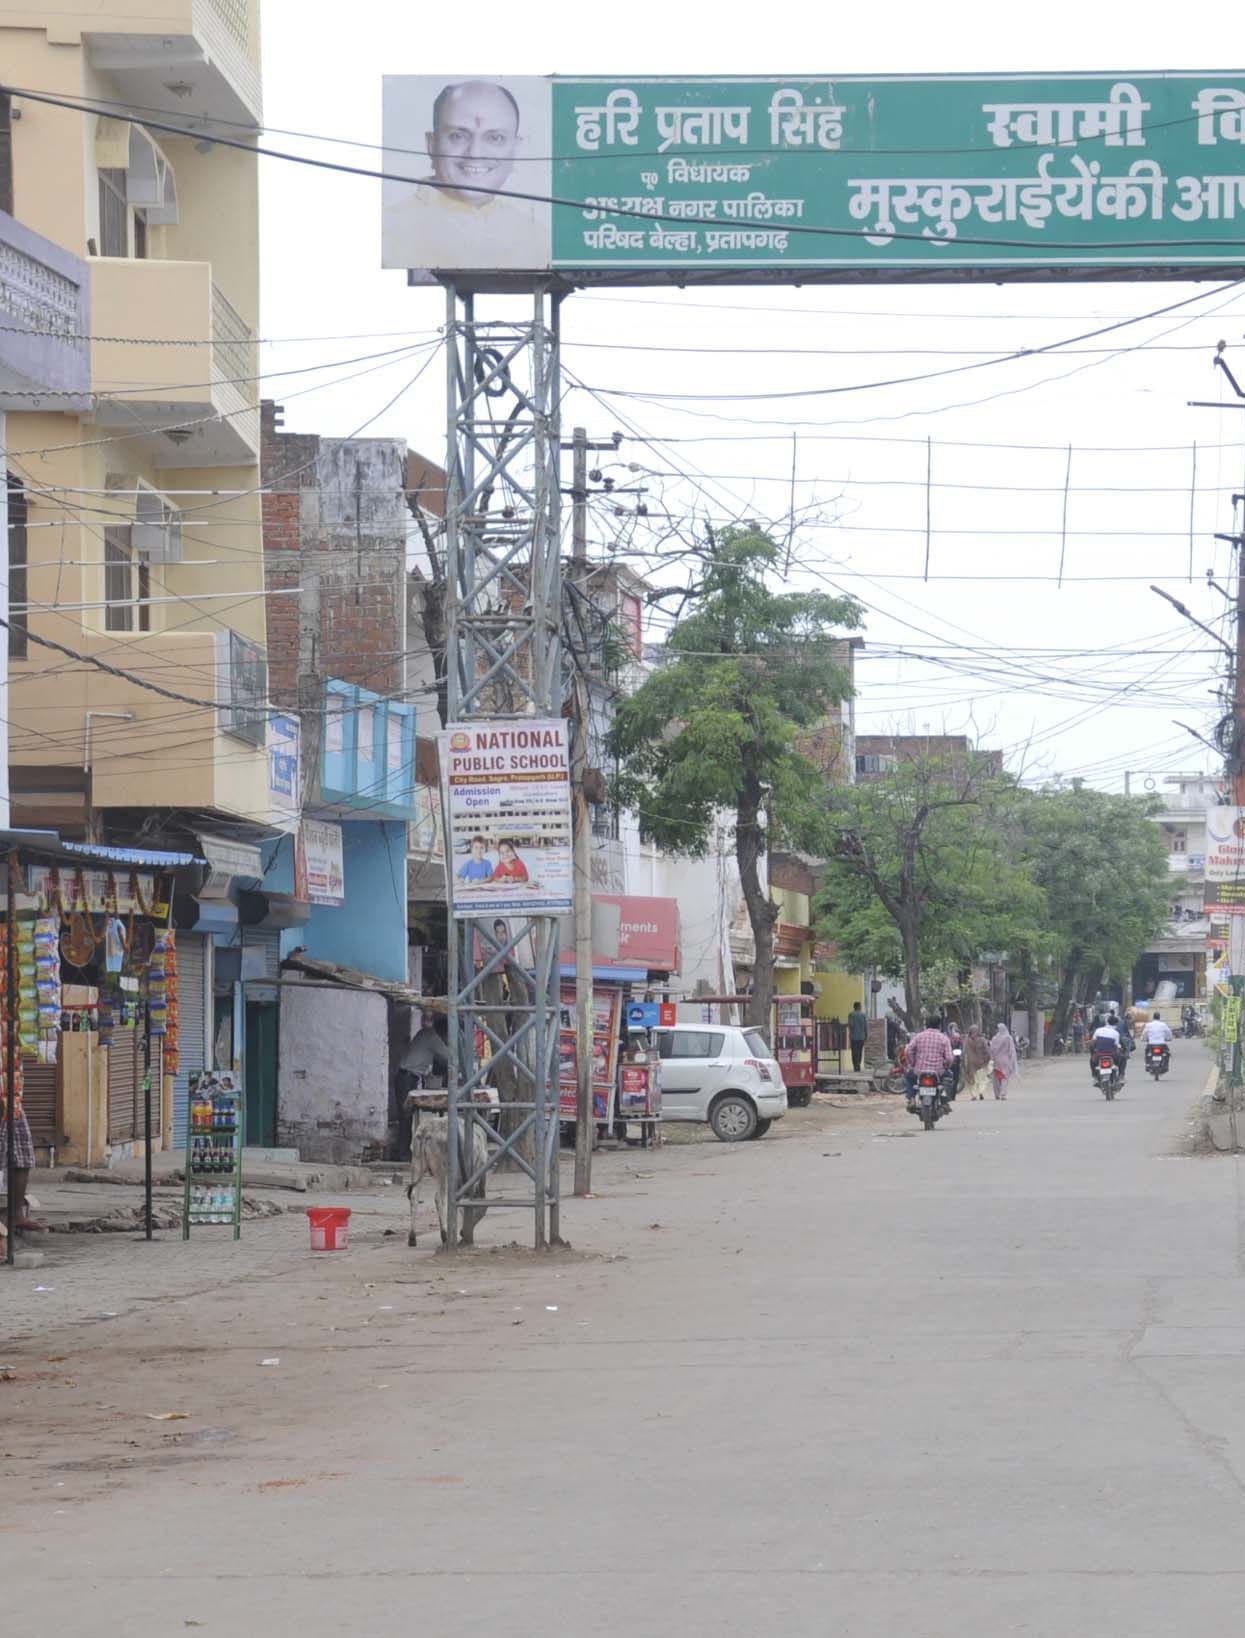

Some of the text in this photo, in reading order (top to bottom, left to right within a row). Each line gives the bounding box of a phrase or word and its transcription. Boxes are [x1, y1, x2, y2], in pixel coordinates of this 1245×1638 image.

[574, 89, 846, 153] हरि प्रताप सिंह
[982, 82, 1151, 148] स्वामी
[667, 158, 751, 184] विधायक
[582, 192, 805, 220] अध्यक्ष नगर पालिका
[476, 730, 564, 750] NATIONAL
[453, 754, 567, 772] PUBLIC SCHOOL
[453, 786, 501, 796] Admission
[465, 798, 489, 808] Open
[620, 921, 658, 933] ments
